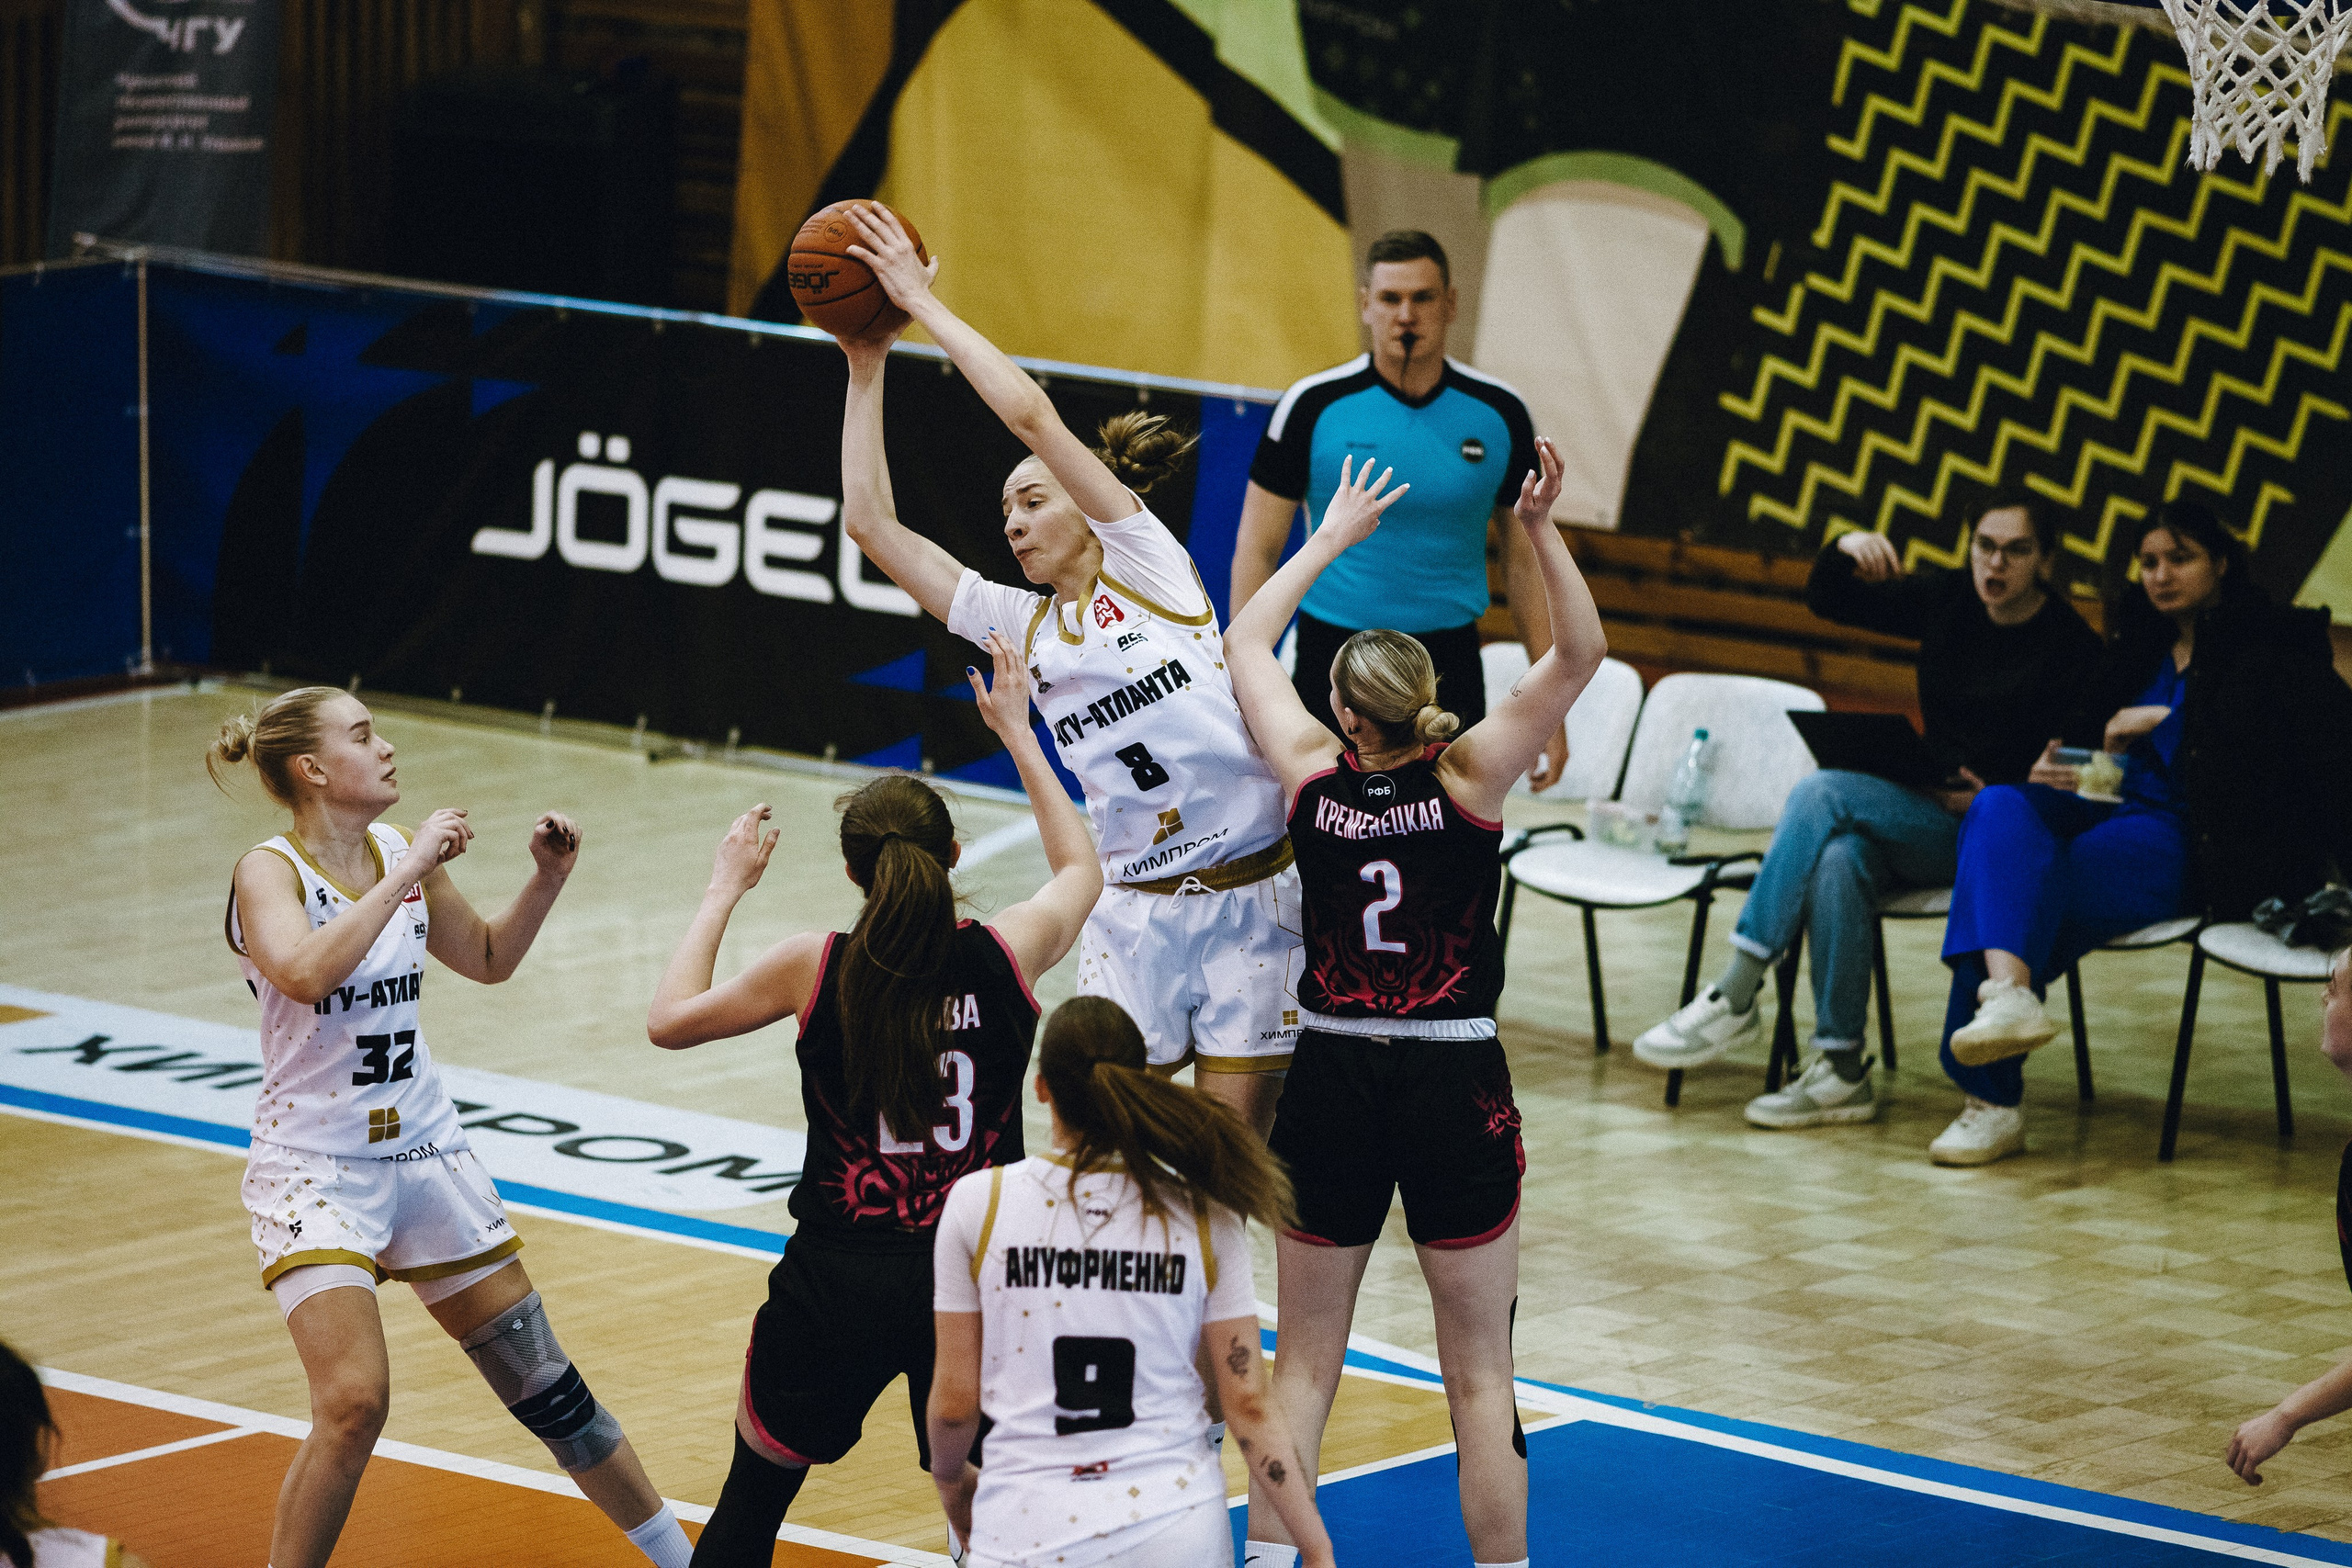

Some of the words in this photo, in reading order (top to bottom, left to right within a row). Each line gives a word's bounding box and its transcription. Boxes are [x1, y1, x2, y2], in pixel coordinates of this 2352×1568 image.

[471, 430, 923, 618] JÖGEL
[1114, 741, 1170, 792] 8
[1367, 785, 1391, 797] РФБ
[1315, 795, 1445, 840] КРЕМЕНЕЦКАЯ
[1358, 858, 1408, 954] 2
[313, 970, 424, 1015] ГУ-АТЛА
[352, 1029, 416, 1086] 32
[1004, 1246, 1188, 1296] АНУФРИЕНКО
[1052, 1334, 1136, 1438] 9
